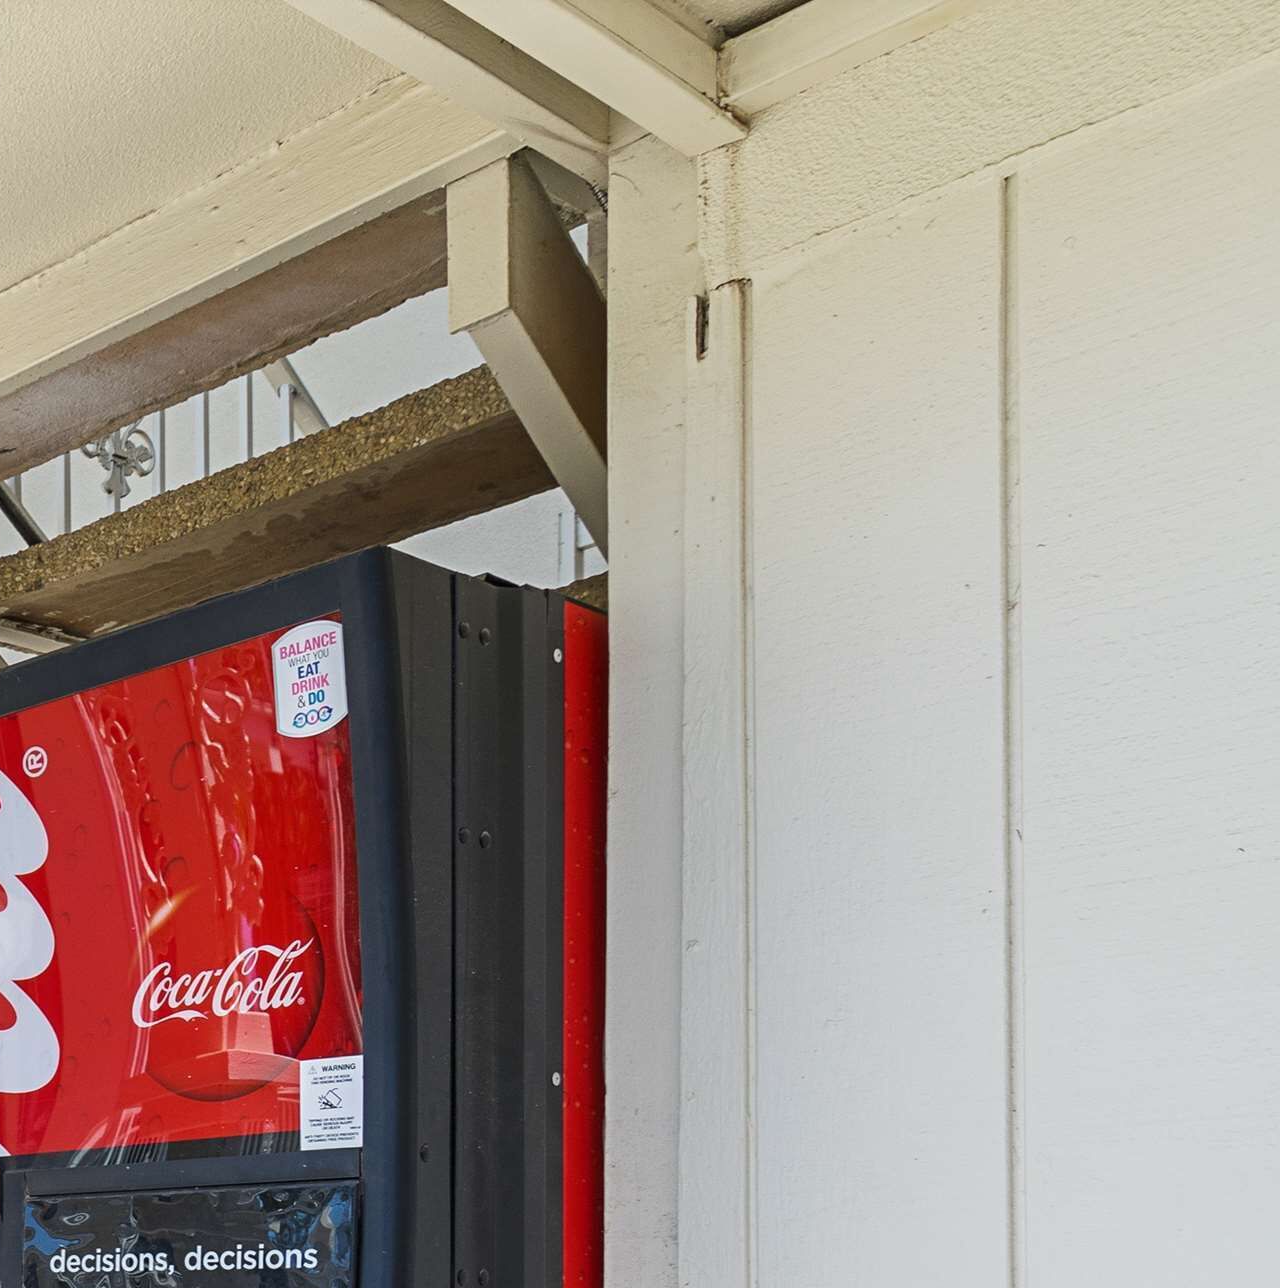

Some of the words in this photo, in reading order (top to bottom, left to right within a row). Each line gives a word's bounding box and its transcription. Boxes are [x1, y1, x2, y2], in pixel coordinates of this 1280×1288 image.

[279, 631, 337, 660] BALANCE
[287, 653, 311, 668] WHAT
[313, 647, 330, 661] YOU
[297, 660, 321, 679] EAT
[291, 673, 330, 696] DRINK
[297, 695, 306, 709] &
[308, 689, 325, 706] DO
[132, 936, 315, 1029] Coca-Cola
[321, 1063, 356, 1073] WARNING
[49, 1248, 175, 1275] decisions,
[184, 1243, 318, 1270] decisions
